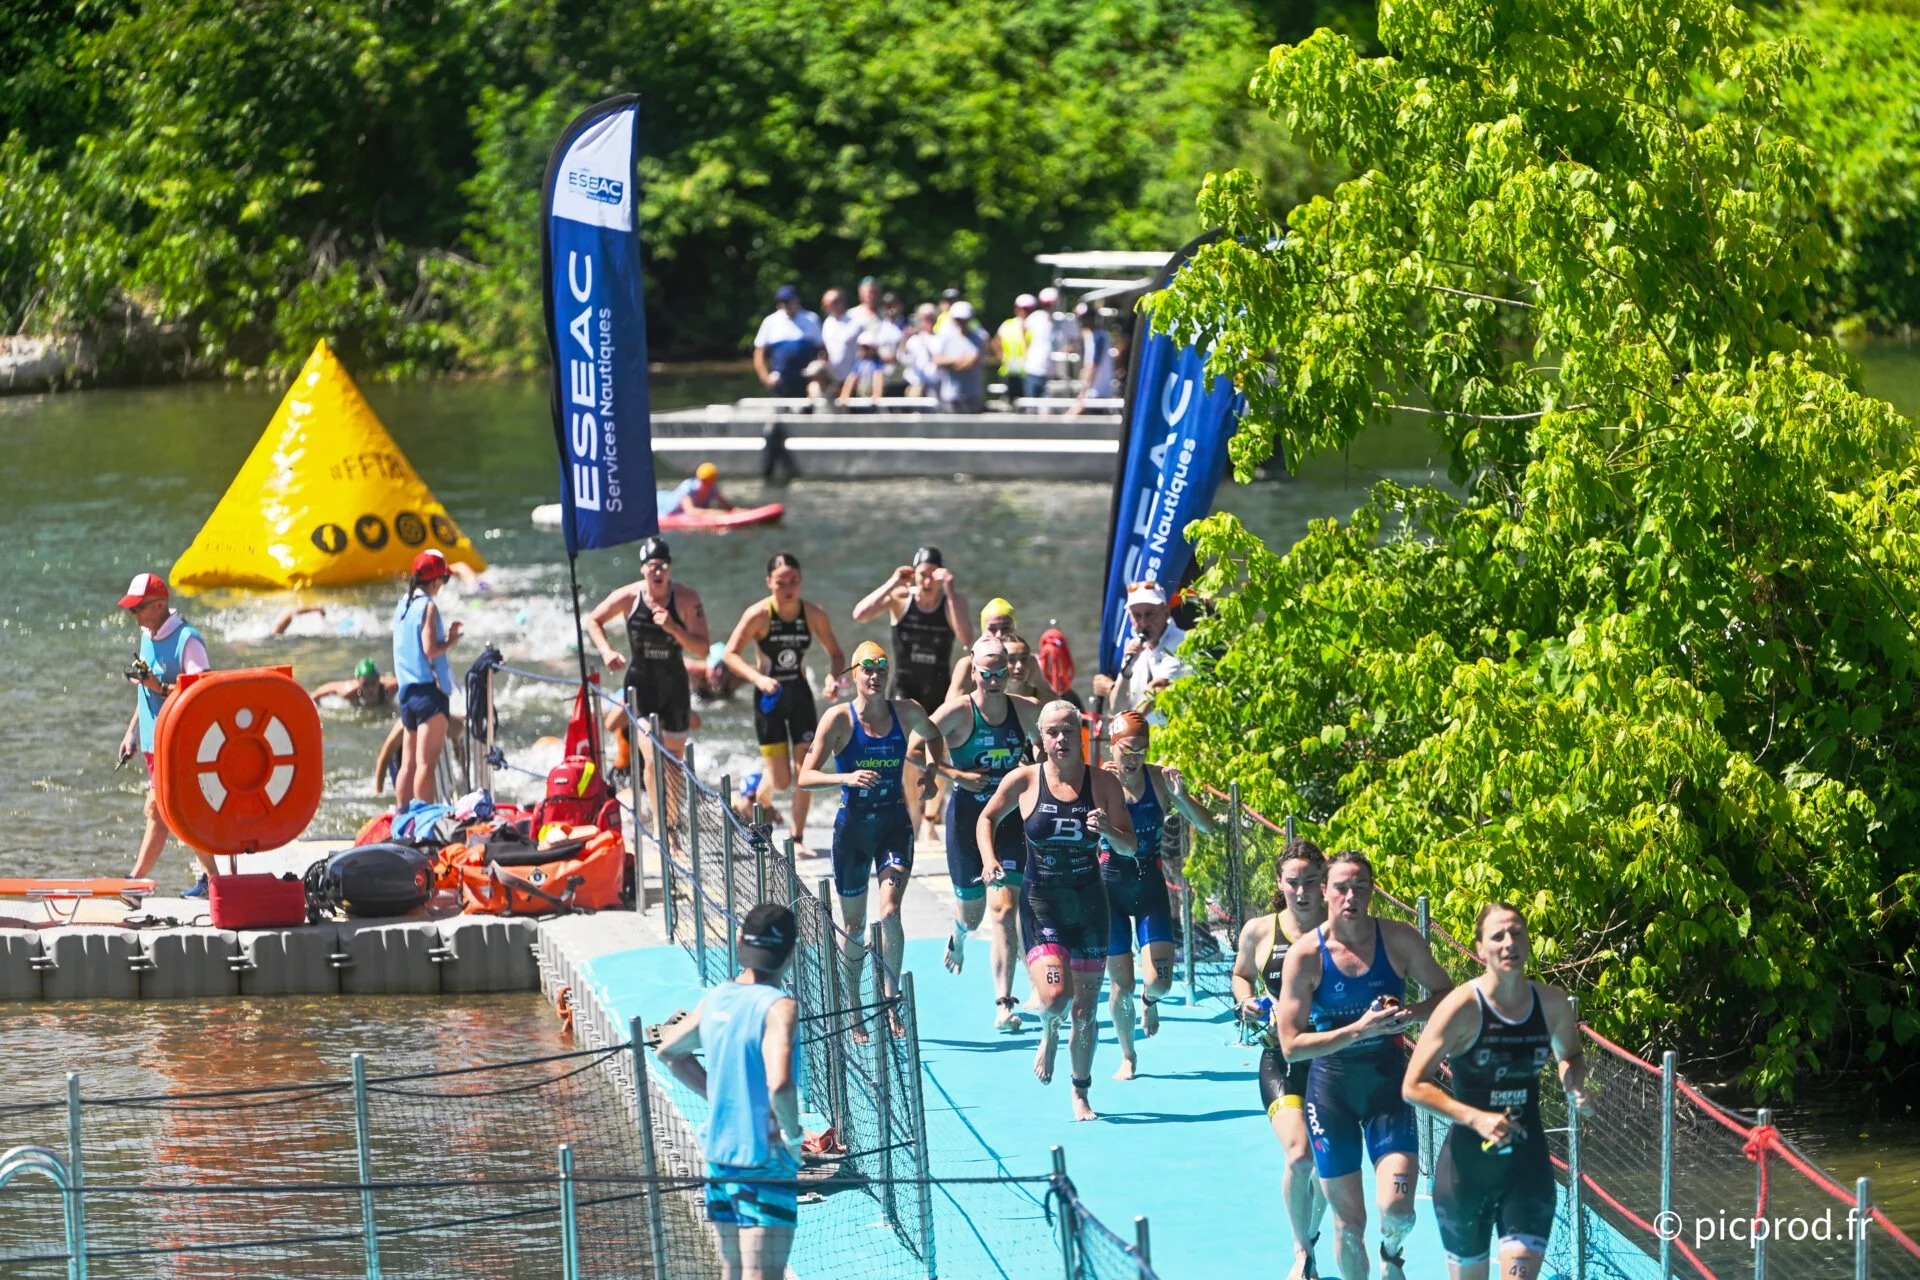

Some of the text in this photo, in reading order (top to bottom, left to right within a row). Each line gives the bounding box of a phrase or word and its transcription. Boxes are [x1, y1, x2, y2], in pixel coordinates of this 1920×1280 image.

[569, 171, 622, 198] ESEAC
[568, 250, 601, 511] ESEAC
[598, 307, 623, 512] Services Nautiques
[1148, 438, 1197, 555] Nautiques
[855, 757, 901, 768] valence
[1046, 972, 1060, 984] 65
[1394, 1182, 1409, 1194] 70
